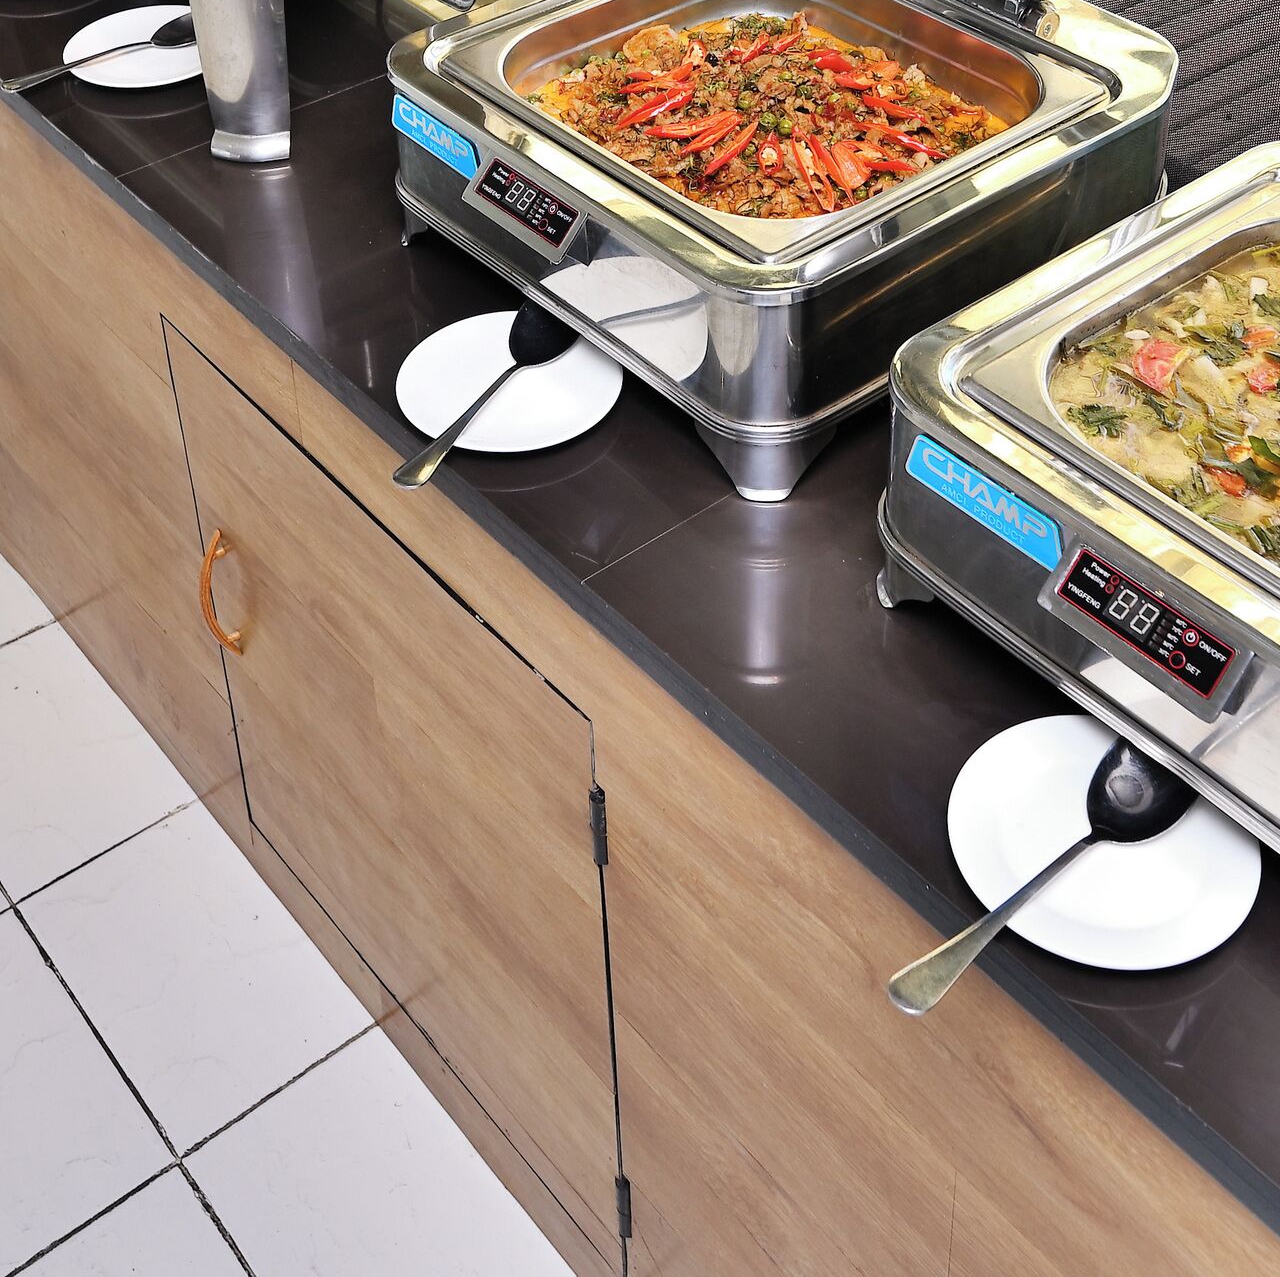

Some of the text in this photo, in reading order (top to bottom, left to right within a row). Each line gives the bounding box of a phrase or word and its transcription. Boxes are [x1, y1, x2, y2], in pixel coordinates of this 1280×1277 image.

[399, 102, 468, 157] CHAMP
[546, 226, 557, 235] SET
[922, 448, 1048, 538] CHAMP
[973, 506, 1026, 543] PRODUCT
[1082, 567, 1106, 588] Heating
[1090, 561, 1111, 578] Power
[1067, 582, 1101, 609] YINGFENG
[1108, 589, 1160, 635] 88
[1199, 640, 1228, 662] ON/OFF
[1185, 662, 1202, 677] SET
